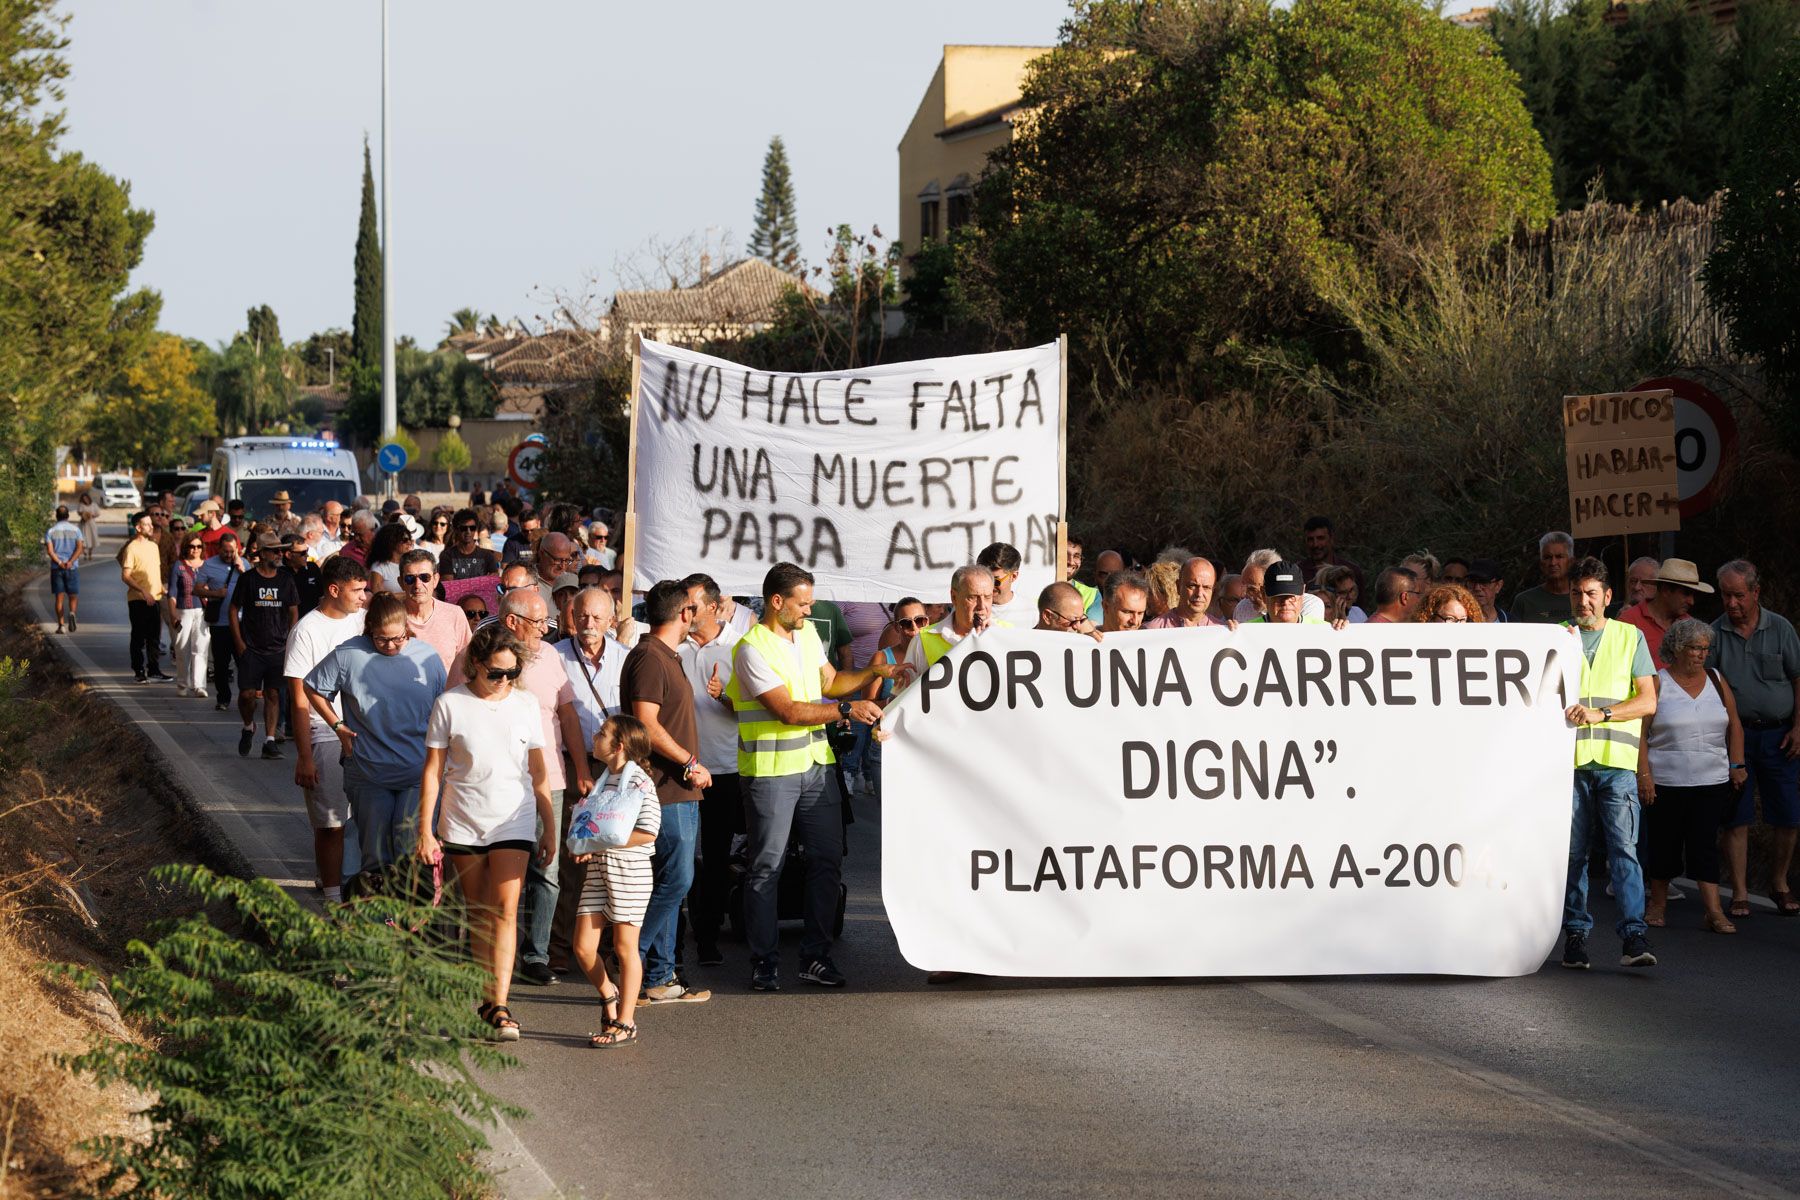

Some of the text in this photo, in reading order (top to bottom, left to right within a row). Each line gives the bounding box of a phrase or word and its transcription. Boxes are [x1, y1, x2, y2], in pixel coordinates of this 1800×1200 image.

[660, 360, 1045, 432] NO HACE FALTA
[1566, 394, 1674, 427] POLITICOS
[692, 442, 1024, 510] UNA MUERTE
[701, 508, 846, 569] PARA
[258, 587, 279, 600] CAT
[921, 648, 1567, 714] POR UNA CARRETERA
[970, 844, 1315, 892] PLATAFORMA
